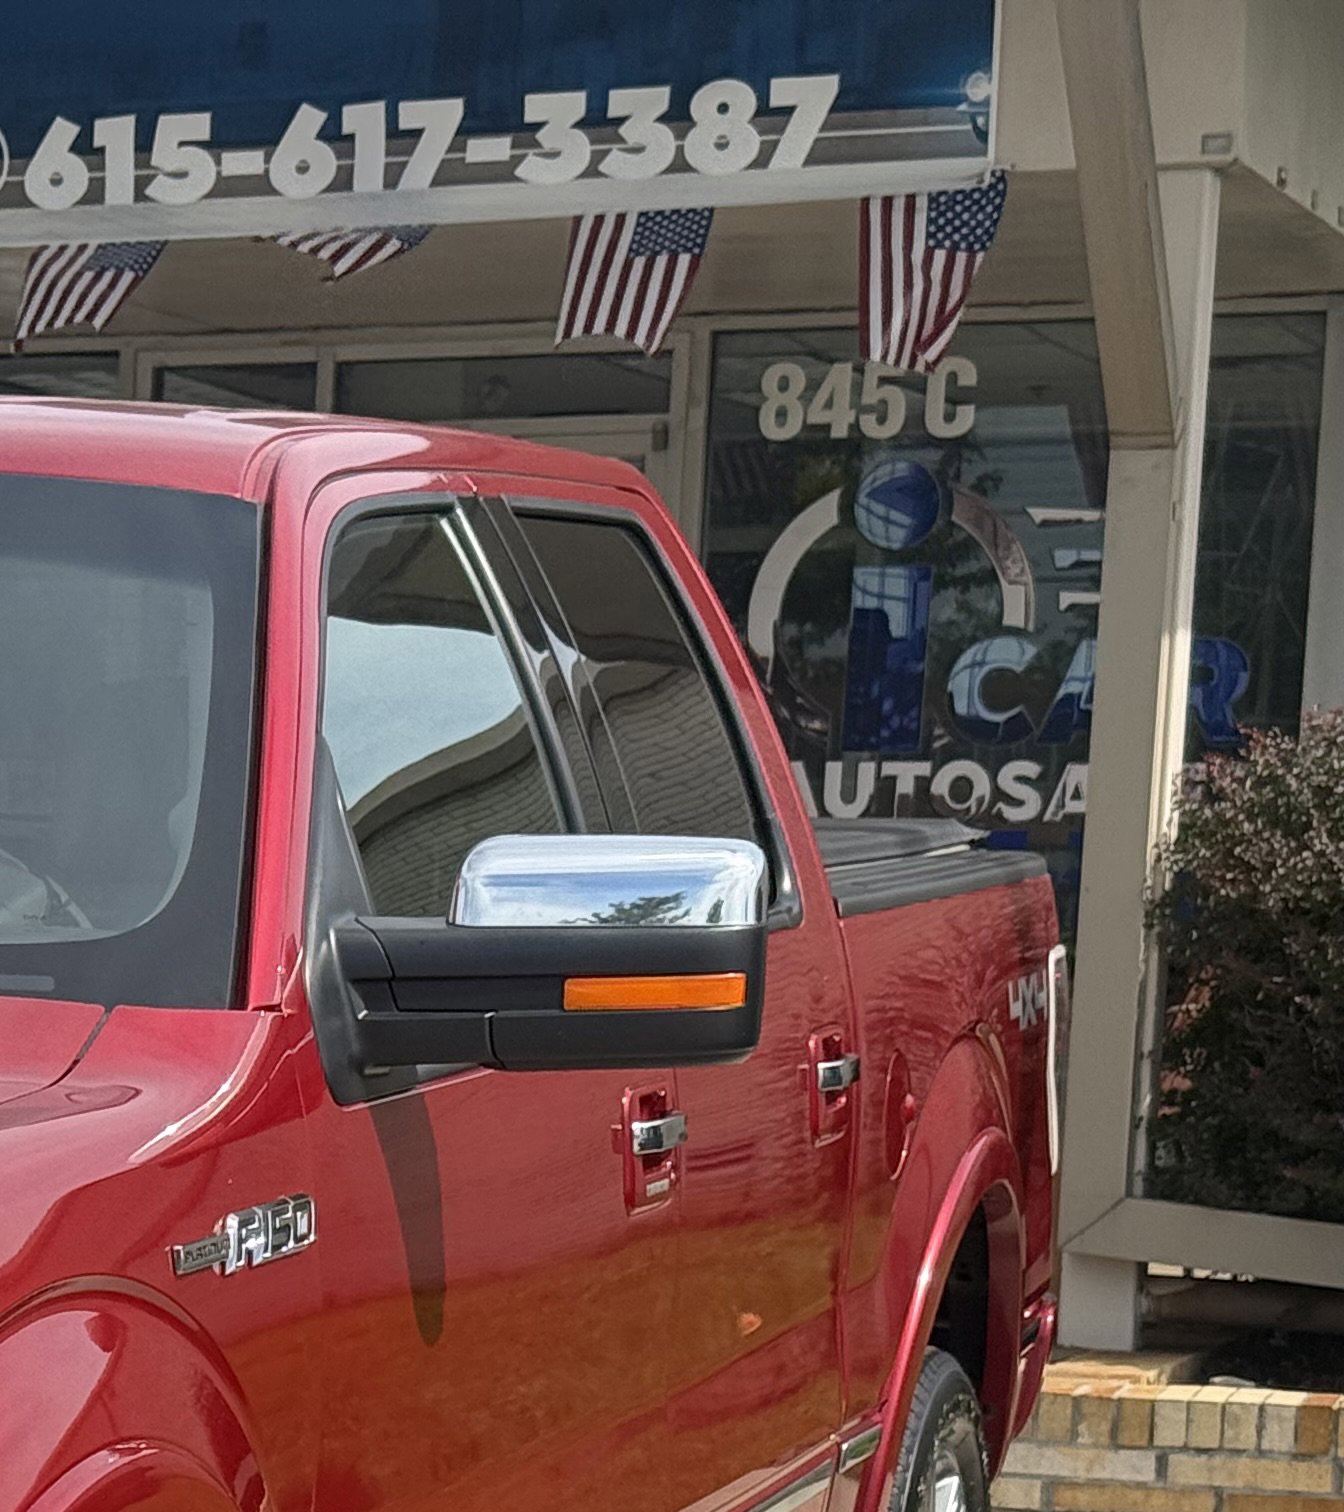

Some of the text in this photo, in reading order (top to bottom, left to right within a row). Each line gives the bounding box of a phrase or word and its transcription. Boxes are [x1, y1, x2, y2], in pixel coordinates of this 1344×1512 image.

[23, 74, 841, 212] 615-617-3387
[759, 356, 978, 441] 845 C
